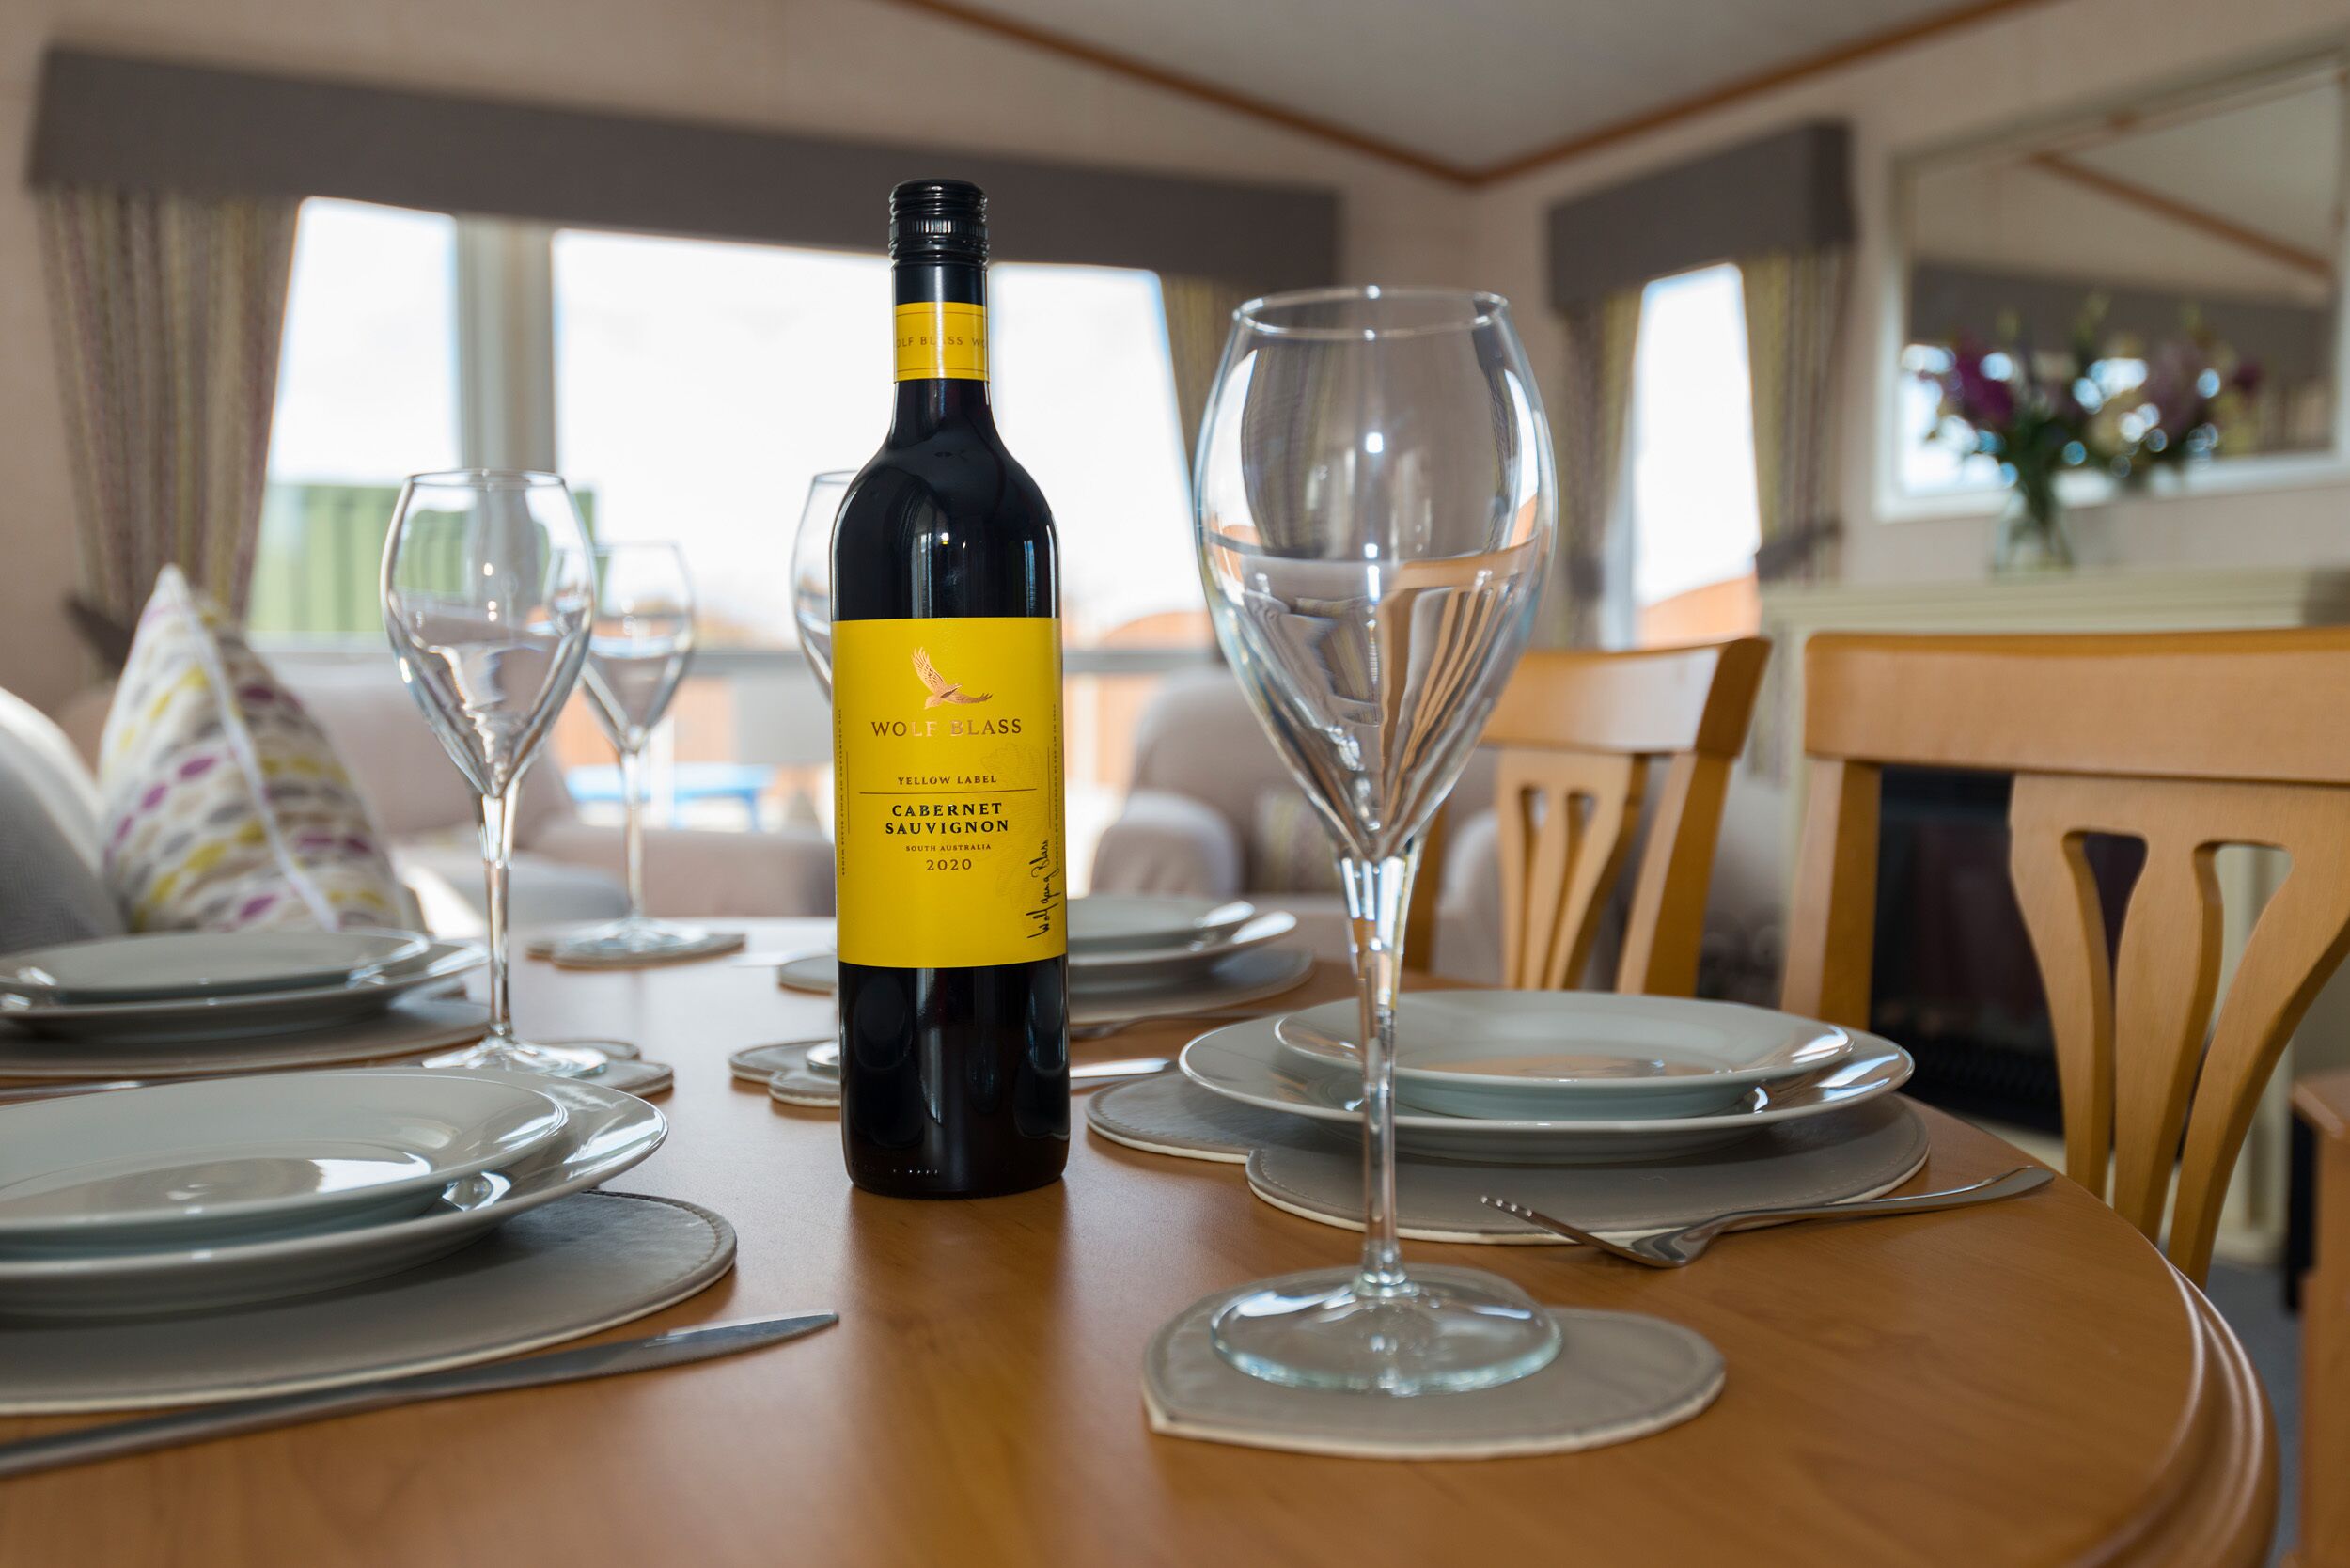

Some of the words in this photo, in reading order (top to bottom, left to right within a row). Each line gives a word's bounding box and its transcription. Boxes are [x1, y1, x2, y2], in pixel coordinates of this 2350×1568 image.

[896, 337, 914, 348] OLF
[920, 336, 964, 346] BLSS
[871, 720, 938, 737] WOLF
[949, 718, 1022, 736] BLASS
[897, 776, 950, 785] YELLOW
[957, 775, 997, 784] LABEL
[892, 802, 1002, 817] CABERNET
[885, 820, 1009, 835] SAUVIGNON
[926, 858, 972, 871] 2020
